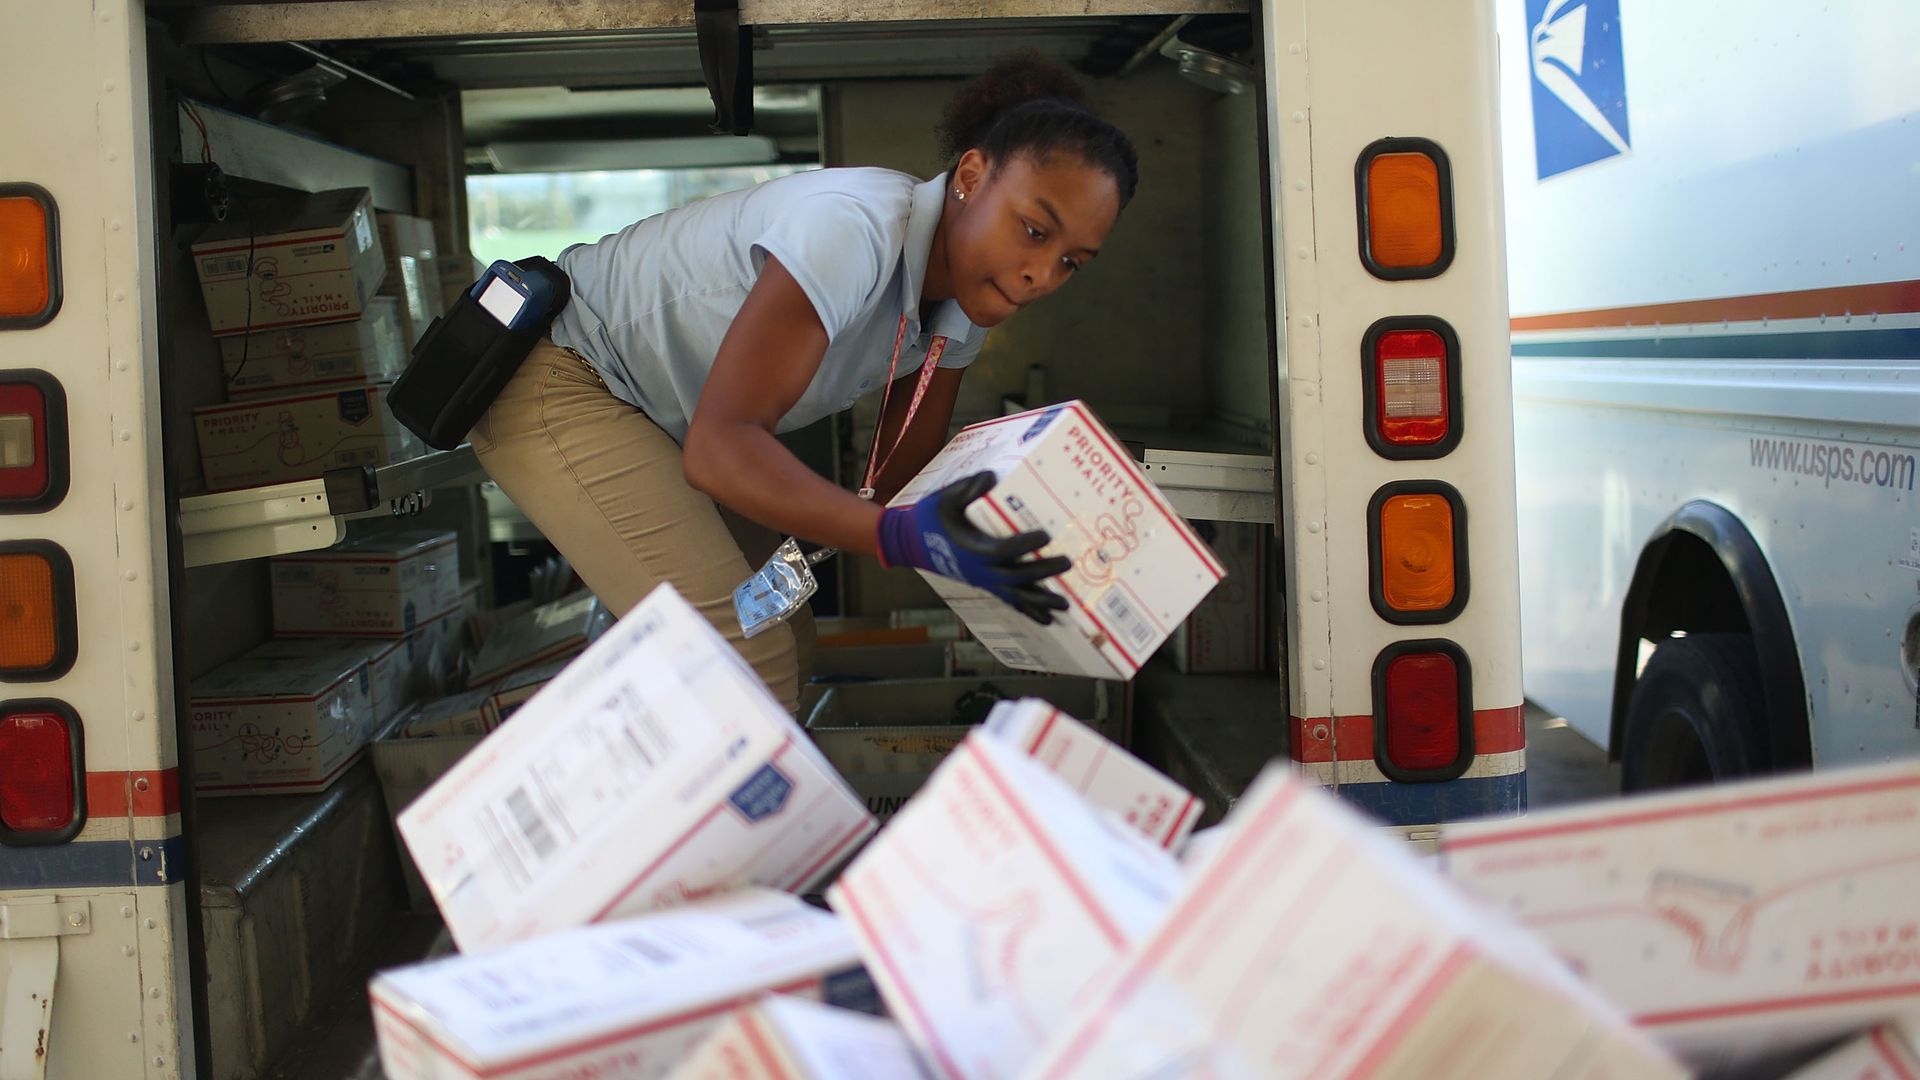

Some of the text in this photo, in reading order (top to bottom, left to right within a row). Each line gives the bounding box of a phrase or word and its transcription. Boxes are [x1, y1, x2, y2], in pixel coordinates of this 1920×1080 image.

[302, 294, 334, 304] MAIL
[288, 301, 350, 317] PRIORITY
[203, 412, 259, 429] PRIORITY
[218, 426, 249, 436] MAIL
[1068, 427, 1132, 499] PRIORITY
[1750, 438, 1915, 490] www.usps.com
[1071, 456, 1106, 497] MAIL
[192, 711, 233, 722] ORITY
